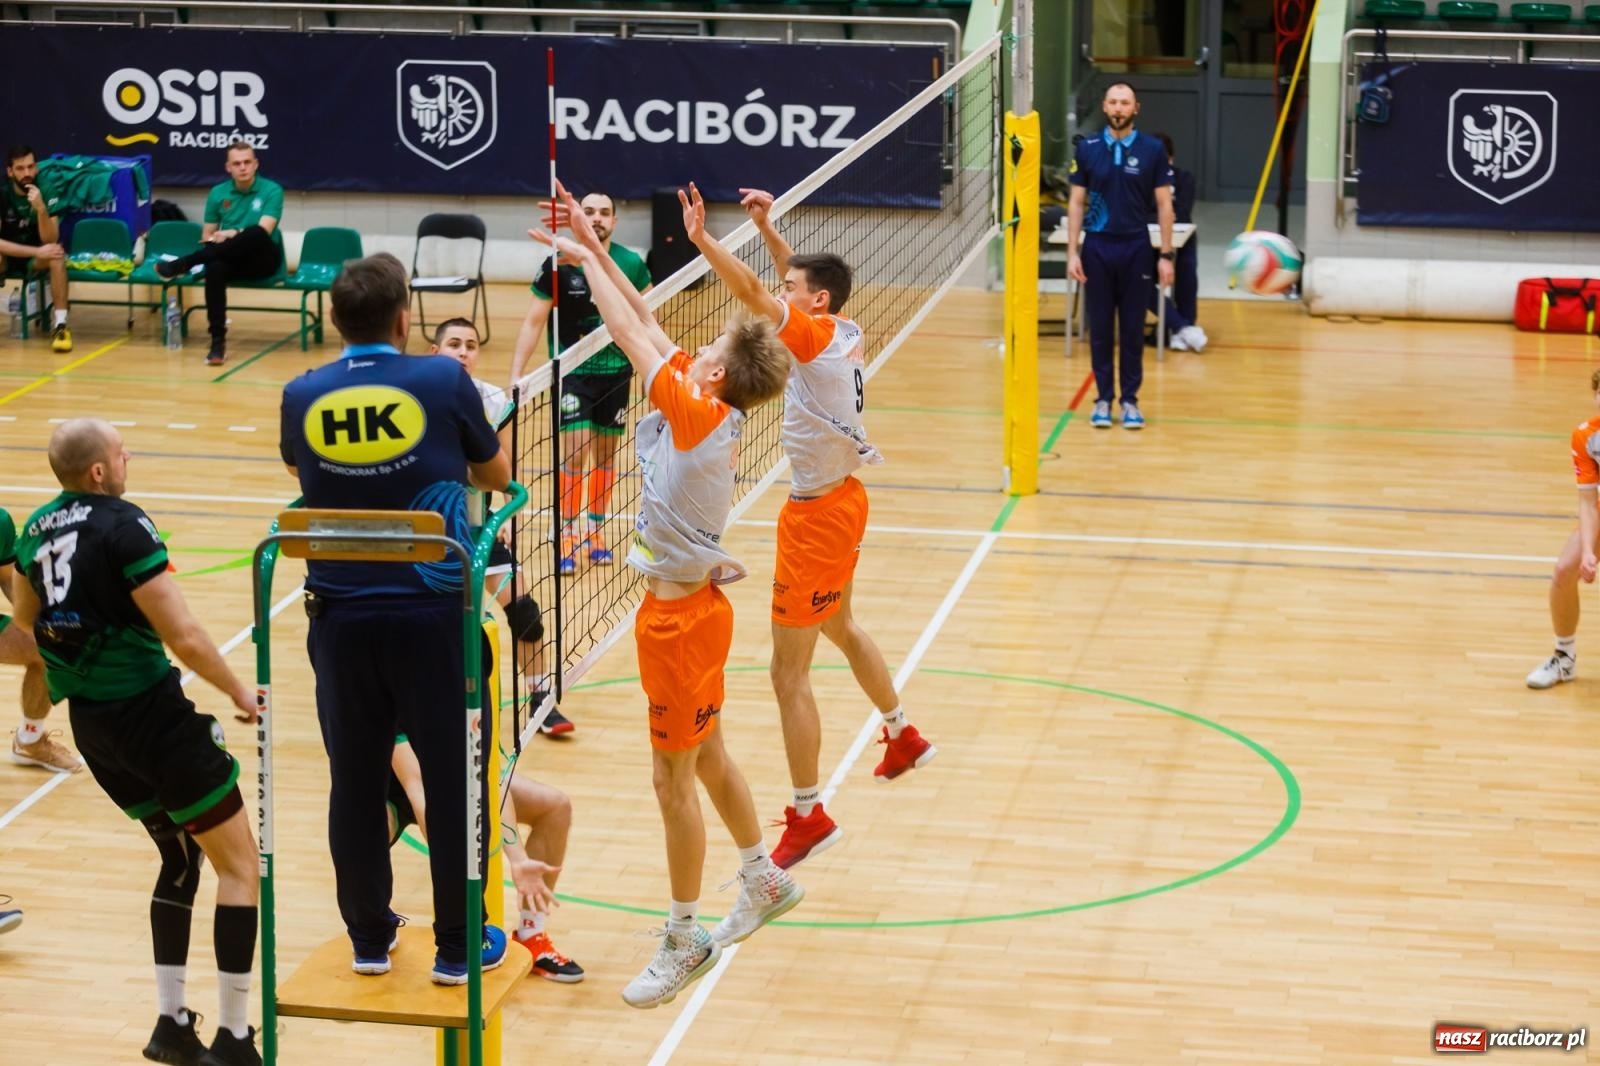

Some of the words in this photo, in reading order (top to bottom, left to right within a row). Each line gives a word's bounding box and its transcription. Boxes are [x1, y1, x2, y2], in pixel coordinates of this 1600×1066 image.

[102, 67, 269, 128] OSiR
[554, 87, 857, 148] RACIBÓRZ
[169, 128, 269, 149] RACIBÓRZ
[854, 367, 864, 414] 9
[321, 402, 406, 446] HK
[33, 530, 79, 606] 13
